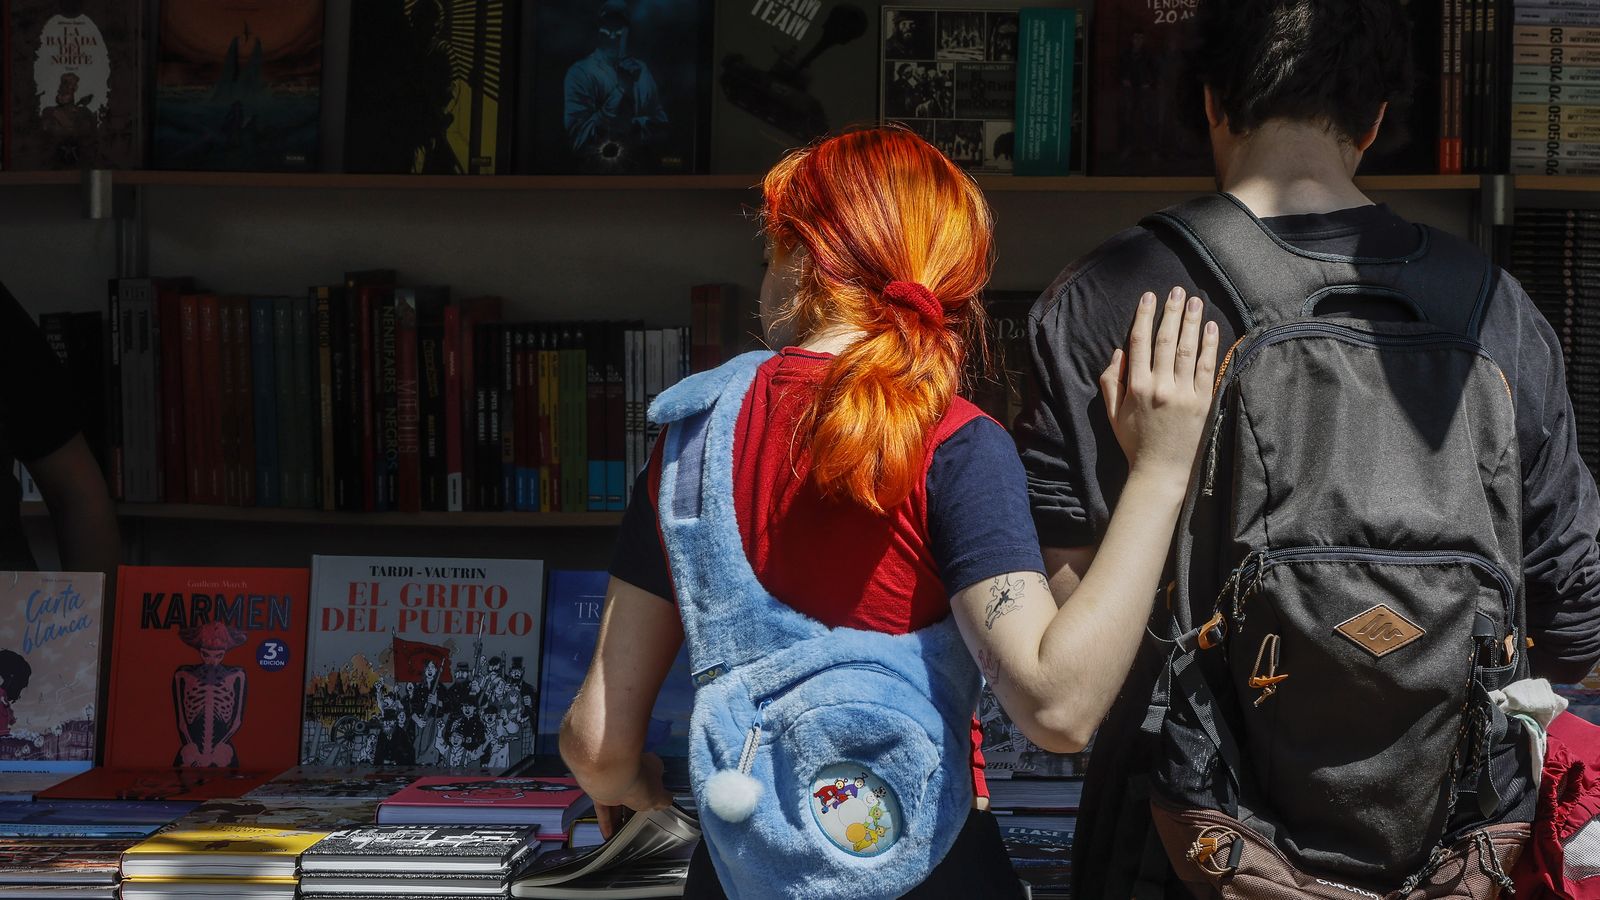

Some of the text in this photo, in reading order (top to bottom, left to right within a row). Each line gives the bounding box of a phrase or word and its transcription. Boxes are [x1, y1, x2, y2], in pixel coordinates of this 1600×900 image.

[751, 0, 811, 41] TEAM
[1154, 10, 1178, 24] 20
[64, 27, 79, 36] LA
[1550, 28, 1563, 43] 03
[46, 36, 97, 46] BALADA
[51, 55, 93, 65] NORTE
[1550, 47, 1563, 63] 03
[1549, 65, 1562, 82] 04
[1548, 85, 1561, 103] 04
[1548, 105, 1561, 122] 05
[1548, 123, 1560, 140] 05
[1546, 142, 1560, 158] 06
[1545, 159, 1559, 176] 06
[626, 401, 634, 436] DUNE
[635, 401, 643, 436] DUNE
[385, 407, 399, 470] NEGROS
[369, 565, 413, 577] TARDI
[424, 566, 487, 579] VAUTRIN
[26, 584, 85, 623] Carta
[348, 582, 508, 609] EL GRITO
[141, 593, 292, 631] KARMEN
[574, 601, 601, 619] TR
[321, 607, 533, 636] DEL PUEBLO
[22, 613, 93, 655] blanca
[263, 642, 284, 660] 3ª
